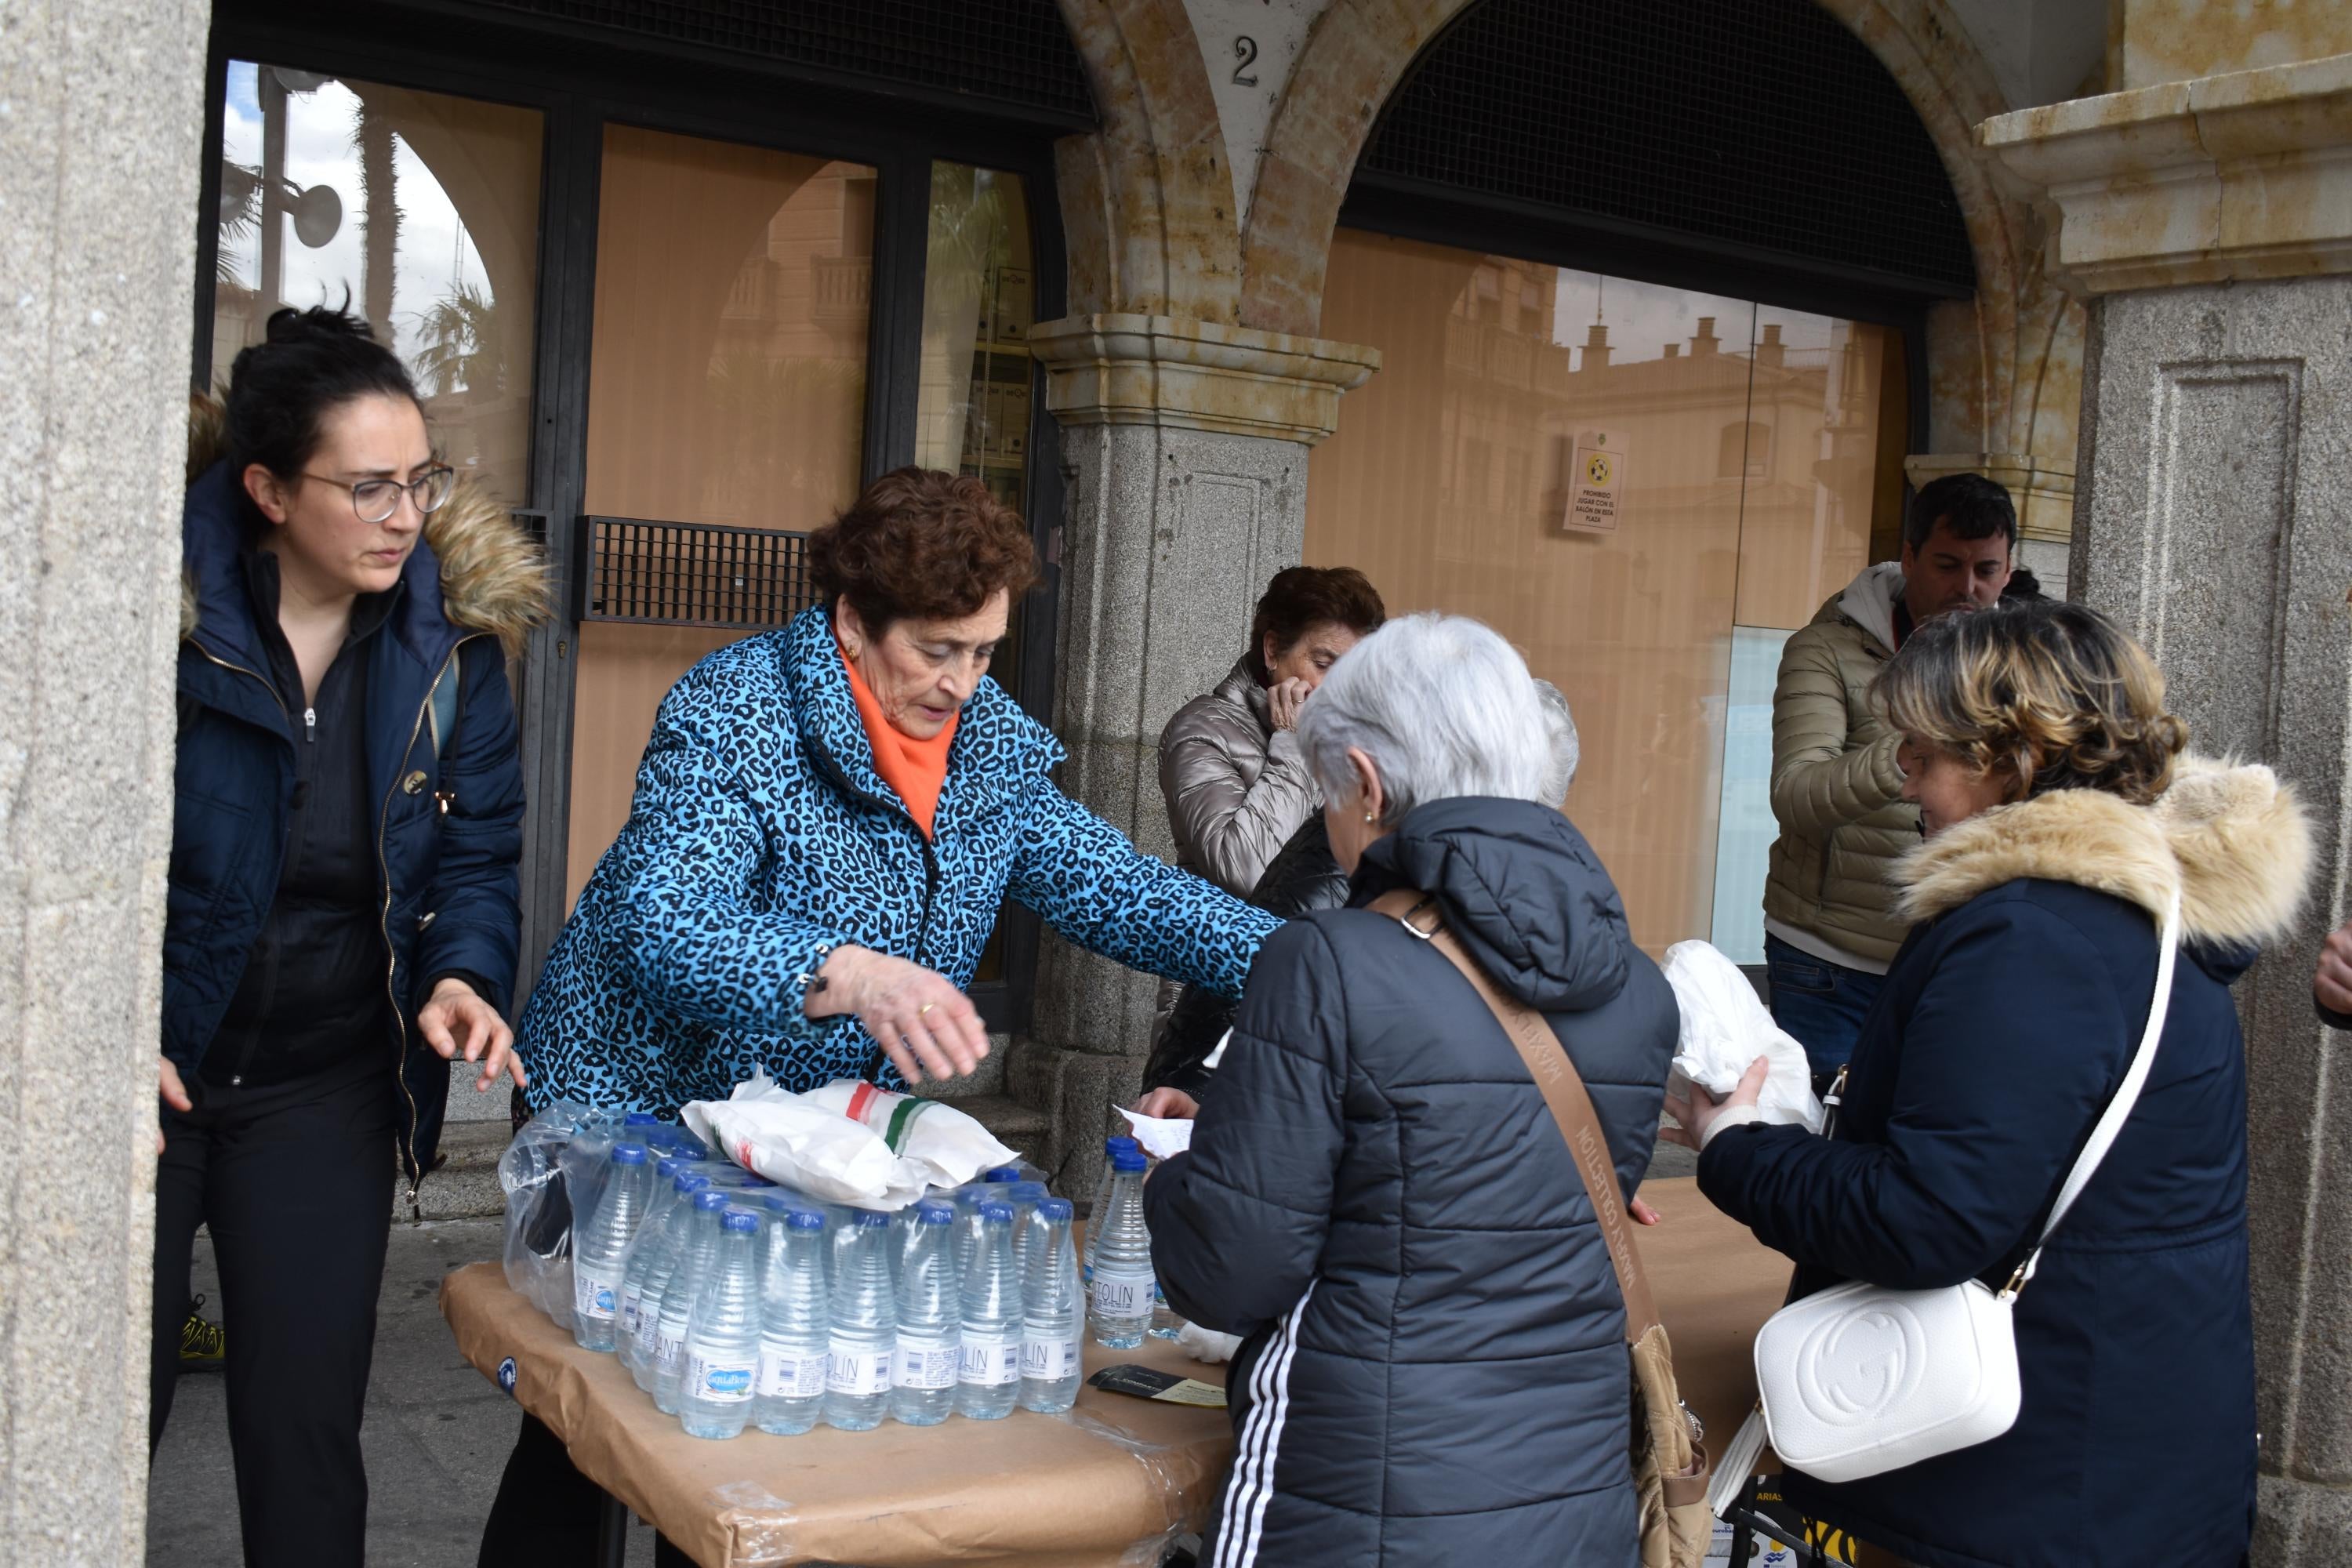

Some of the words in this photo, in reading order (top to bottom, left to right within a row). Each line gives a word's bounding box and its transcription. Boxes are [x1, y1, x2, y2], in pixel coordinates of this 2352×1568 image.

[1232, 36, 1258, 87] 2
[1577, 495, 1595, 505] JUGAR
[1583, 489, 1611, 499] PROHIBIDO
[1576, 505, 1593, 514] BALÓN
[1585, 514, 1601, 523] PLAZA
[1576, 1123, 1618, 1226] COLLECTION
[1611, 1224, 1636, 1290] MAXFLY
[1022, 1341, 1047, 1364] LÍN
